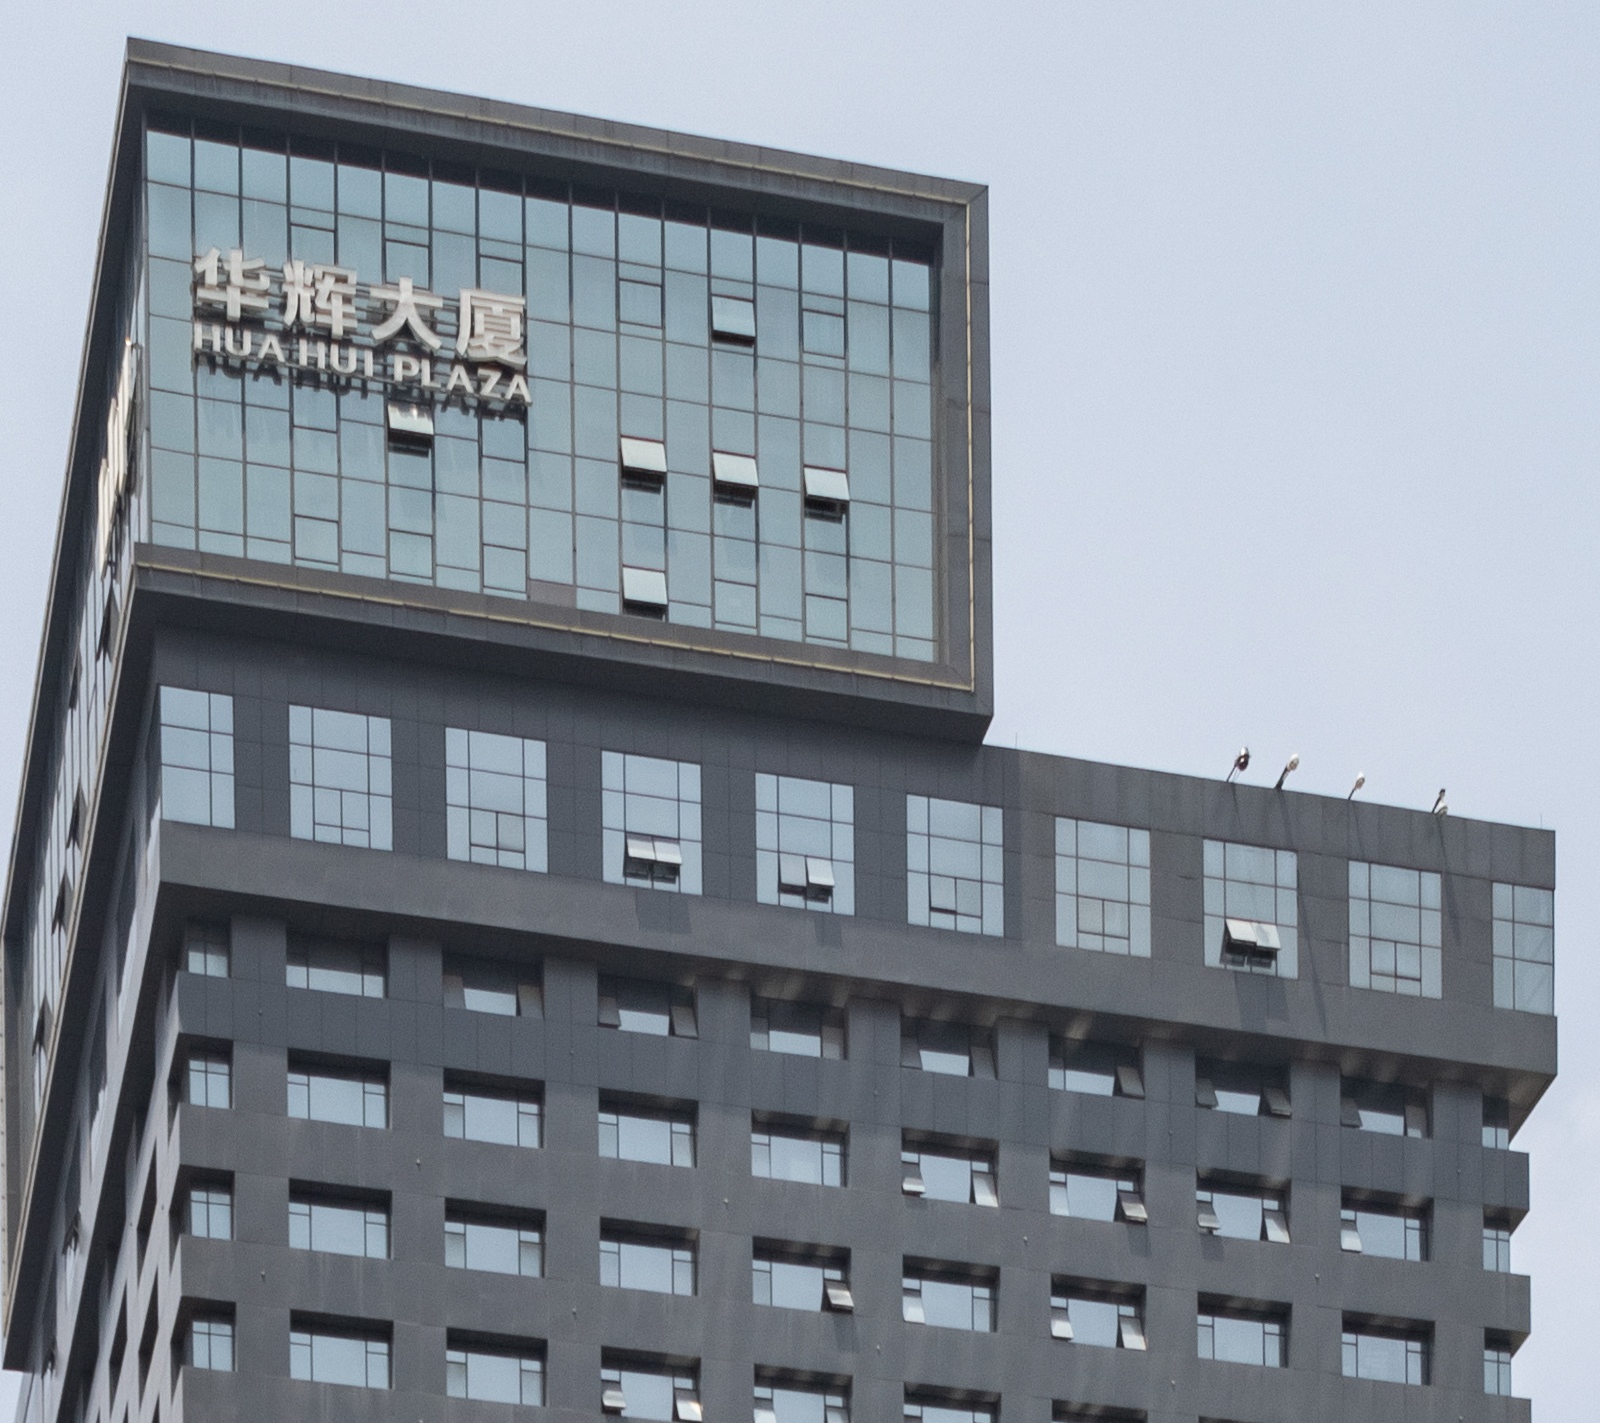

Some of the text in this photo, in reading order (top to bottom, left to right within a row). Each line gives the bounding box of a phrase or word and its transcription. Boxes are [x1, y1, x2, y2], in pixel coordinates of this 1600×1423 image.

[194, 246, 528, 364] 华辉大厦
[194, 323, 533, 406] HUA HUI PLAZA
